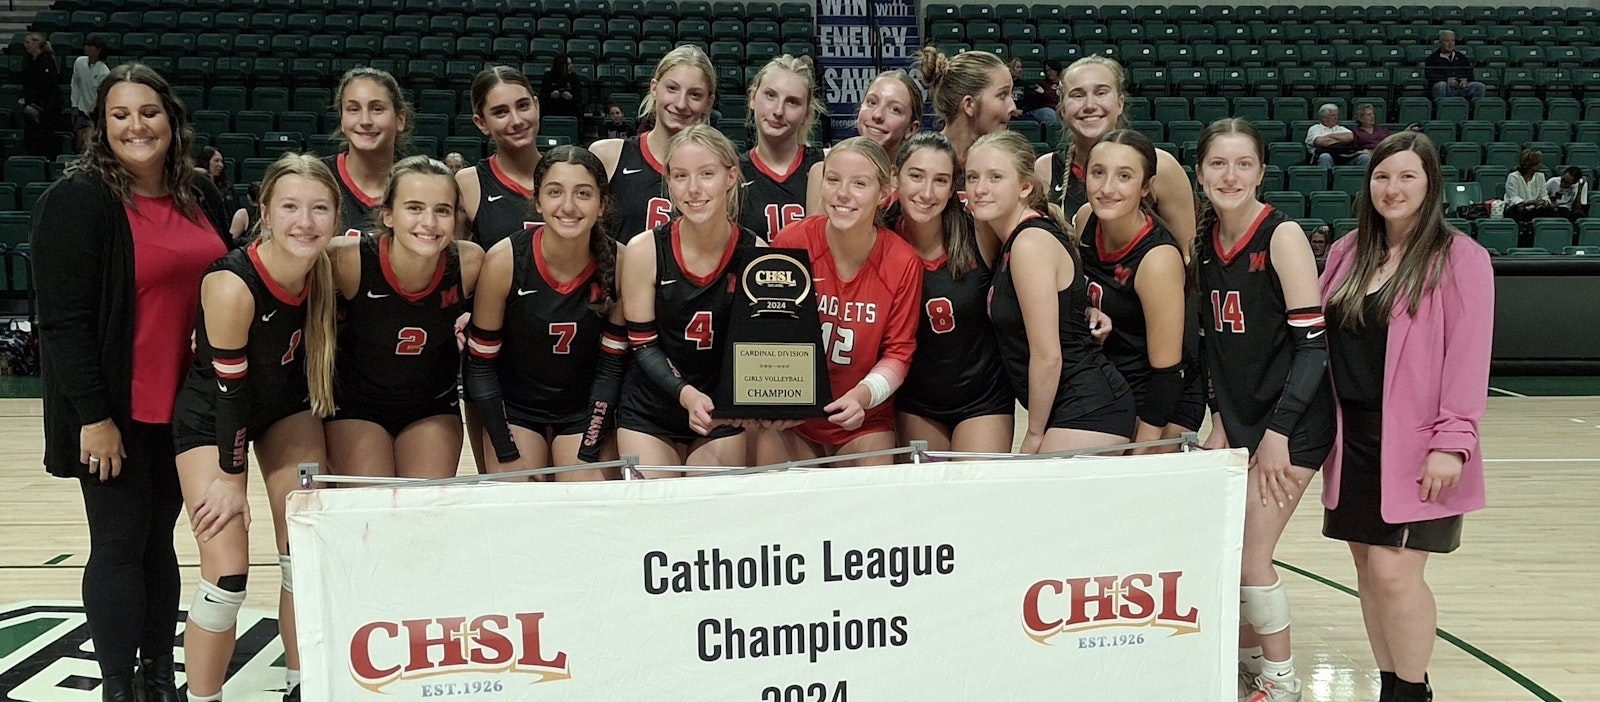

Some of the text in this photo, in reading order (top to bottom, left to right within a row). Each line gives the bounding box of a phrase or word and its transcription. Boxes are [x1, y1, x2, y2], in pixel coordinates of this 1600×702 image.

[755, 270, 797, 286] CHSL
[766, 301, 787, 309] 2024
[815, 292, 876, 323] AGETS
[925, 296, 956, 334] 8
[1210, 289, 1246, 333] 14
[281, 328, 302, 366] 1
[395, 326, 428, 355] 2
[549, 322, 577, 354] 7
[684, 310, 714, 351] 4
[821, 321, 854, 365] 12
[747, 388, 802, 398] CHAMPION
[643, 540, 955, 595] Catholic League
[1022, 571, 1199, 633] CHSL
[349, 611, 567, 680] CHSL
[697, 609, 908, 663] Champions
[1078, 633, 1145, 649] EST.1926
[421, 679, 503, 697] EST.1926
